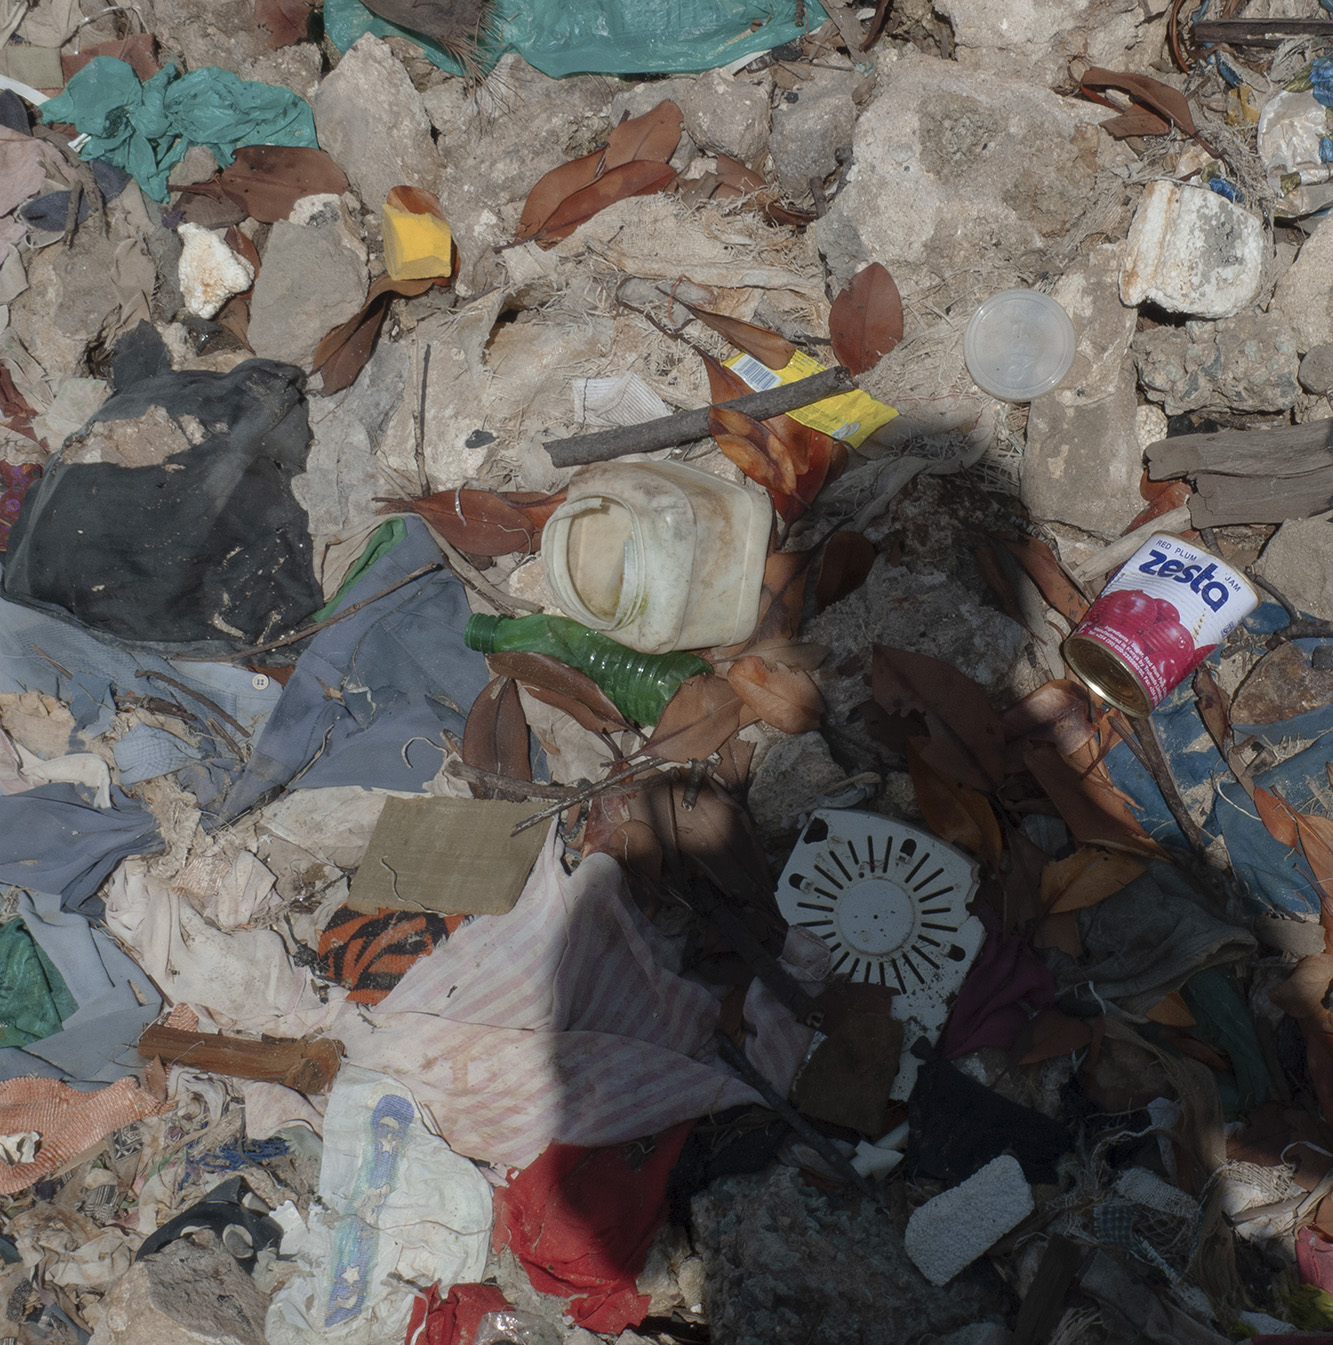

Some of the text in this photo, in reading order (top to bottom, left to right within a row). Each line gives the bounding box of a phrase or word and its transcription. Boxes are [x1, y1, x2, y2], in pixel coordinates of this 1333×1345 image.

[1138, 549, 1229, 613] zesta
[1156, 539, 1242, 592] RED PLUM JAM
[1125, 644, 1139, 661] Kenya
